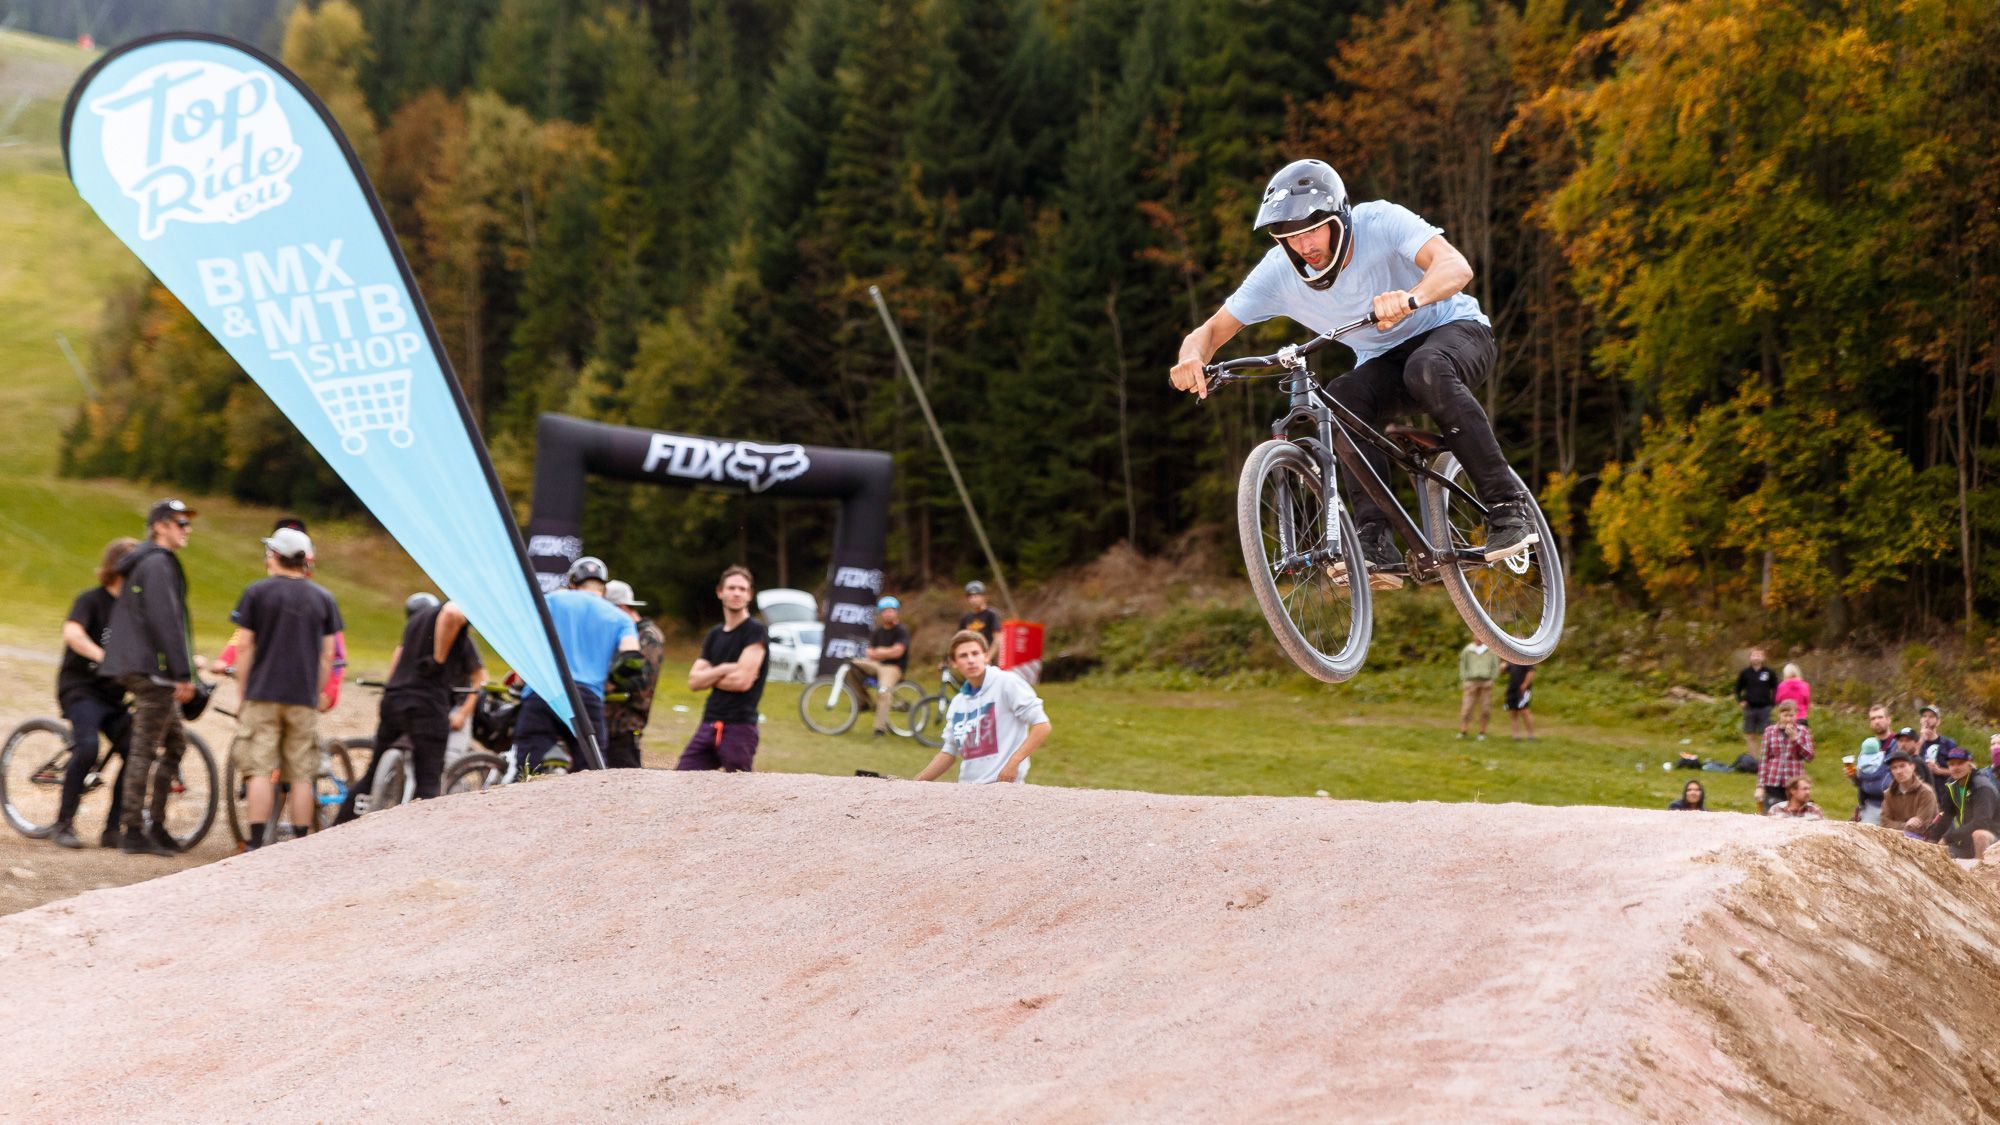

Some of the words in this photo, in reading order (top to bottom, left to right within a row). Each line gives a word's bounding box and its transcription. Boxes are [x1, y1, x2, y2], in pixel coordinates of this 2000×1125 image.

[98, 68, 268, 168] Top
[131, 131, 295, 234] Ride
[196, 239, 355, 306] BMX
[222, 305, 256, 338] &
[254, 283, 407, 350] MTB
[308, 331, 421, 376] SHOP
[641, 433, 735, 481] FOX
